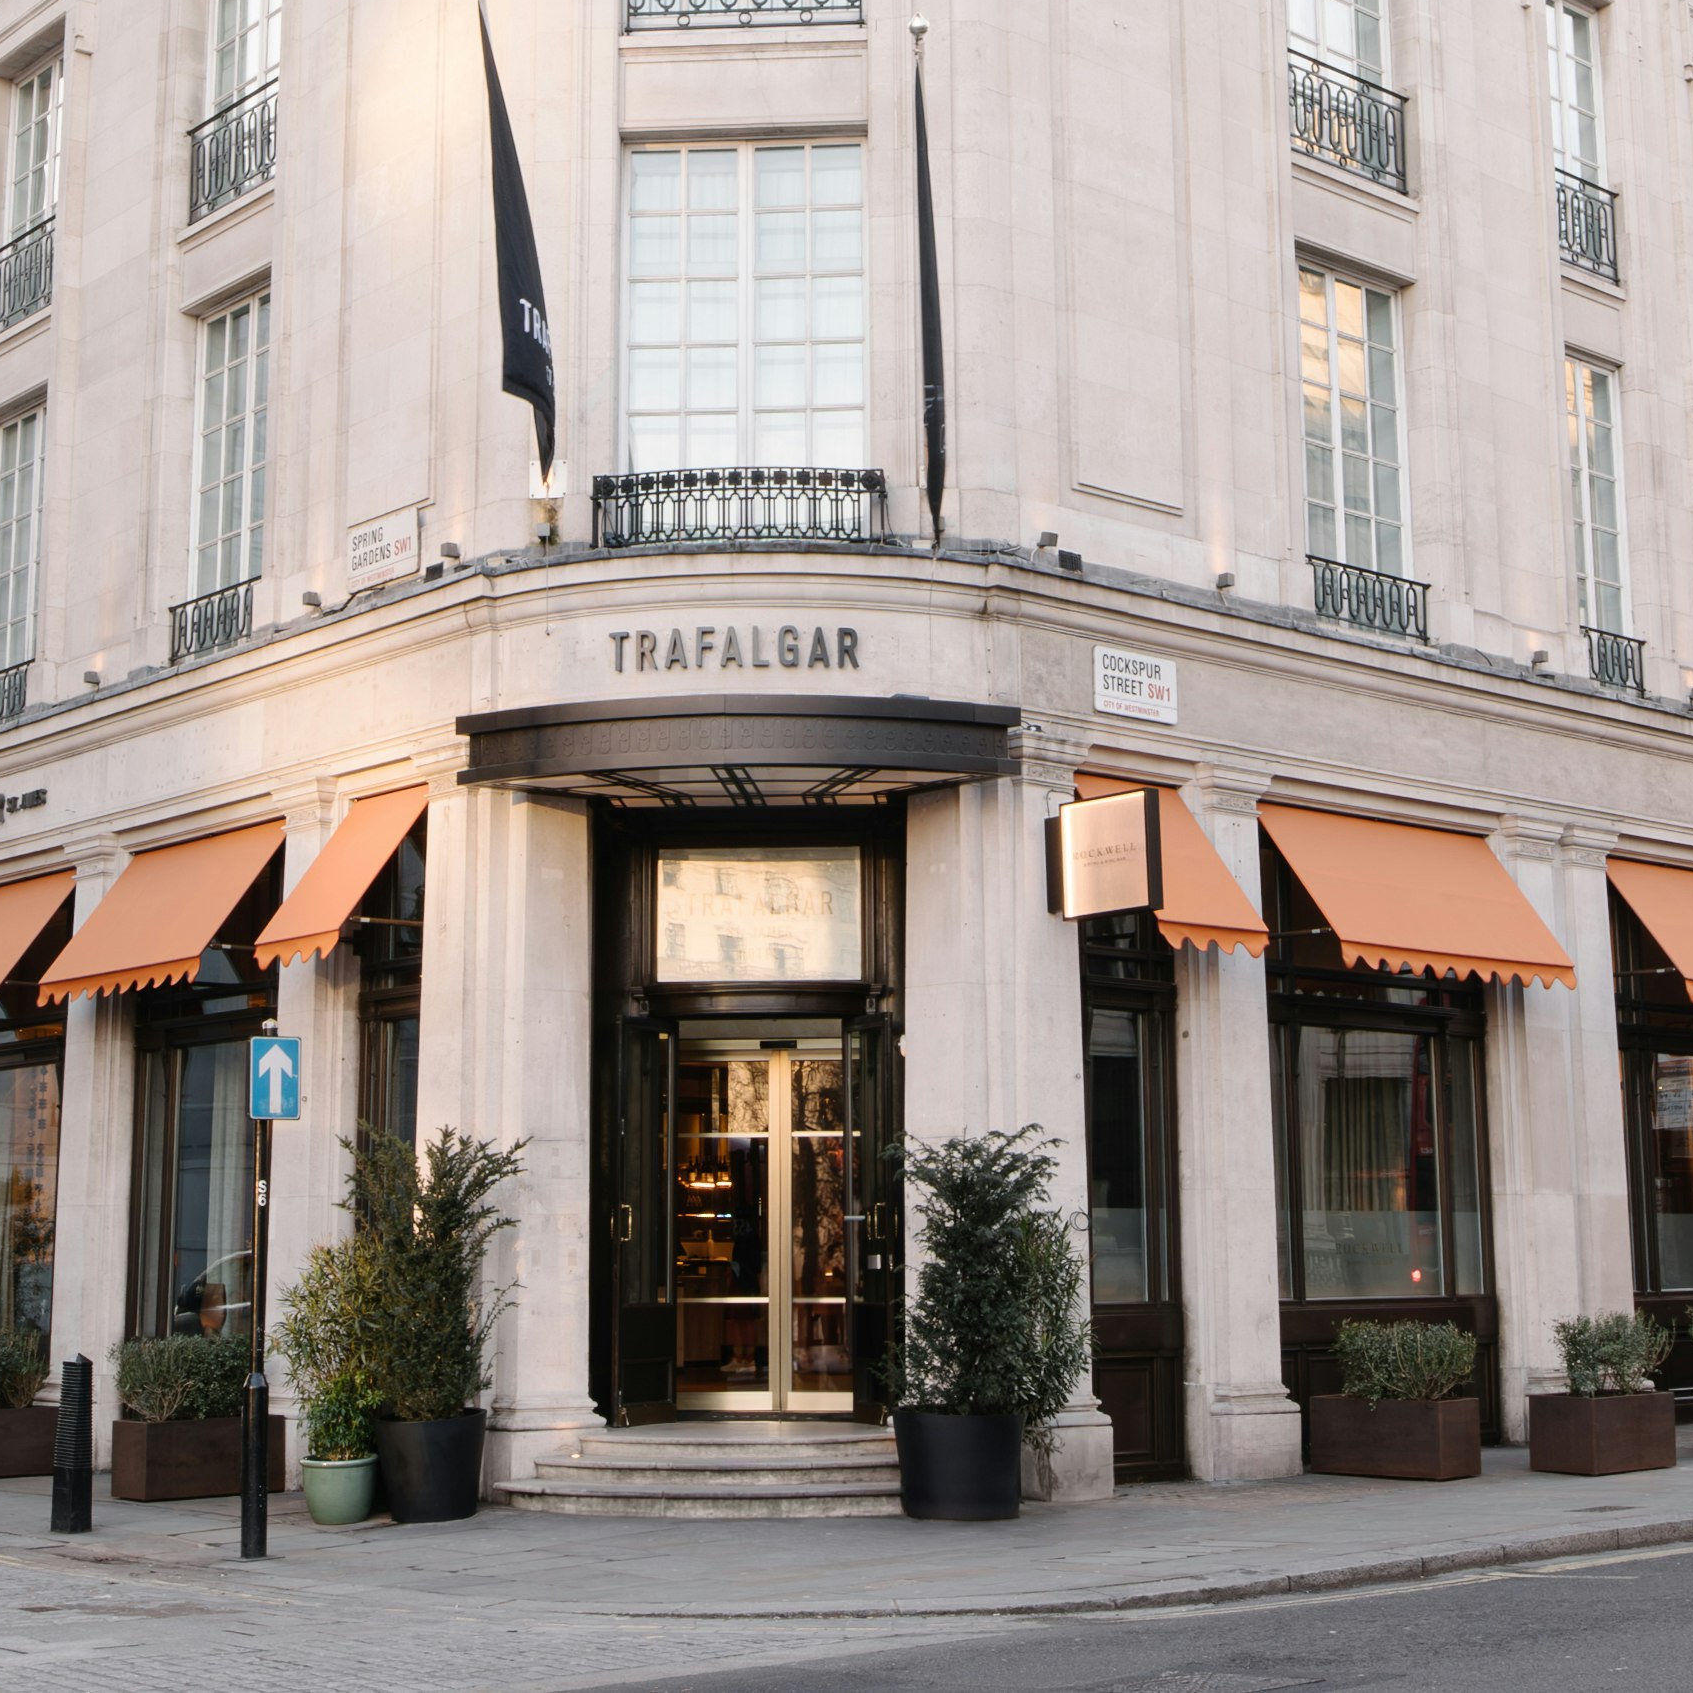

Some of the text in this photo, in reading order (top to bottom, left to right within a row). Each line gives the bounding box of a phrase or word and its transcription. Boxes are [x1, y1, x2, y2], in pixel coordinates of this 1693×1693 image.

[519, 298, 552, 359] TRA
[351, 536, 411, 571] GARDENS SW1
[352, 526, 384, 552] SPRING
[608, 624, 860, 673] TRAFALGAR
[1102, 653, 1161, 681] COCKSPUR
[1103, 674, 1171, 702] STREET SW1
